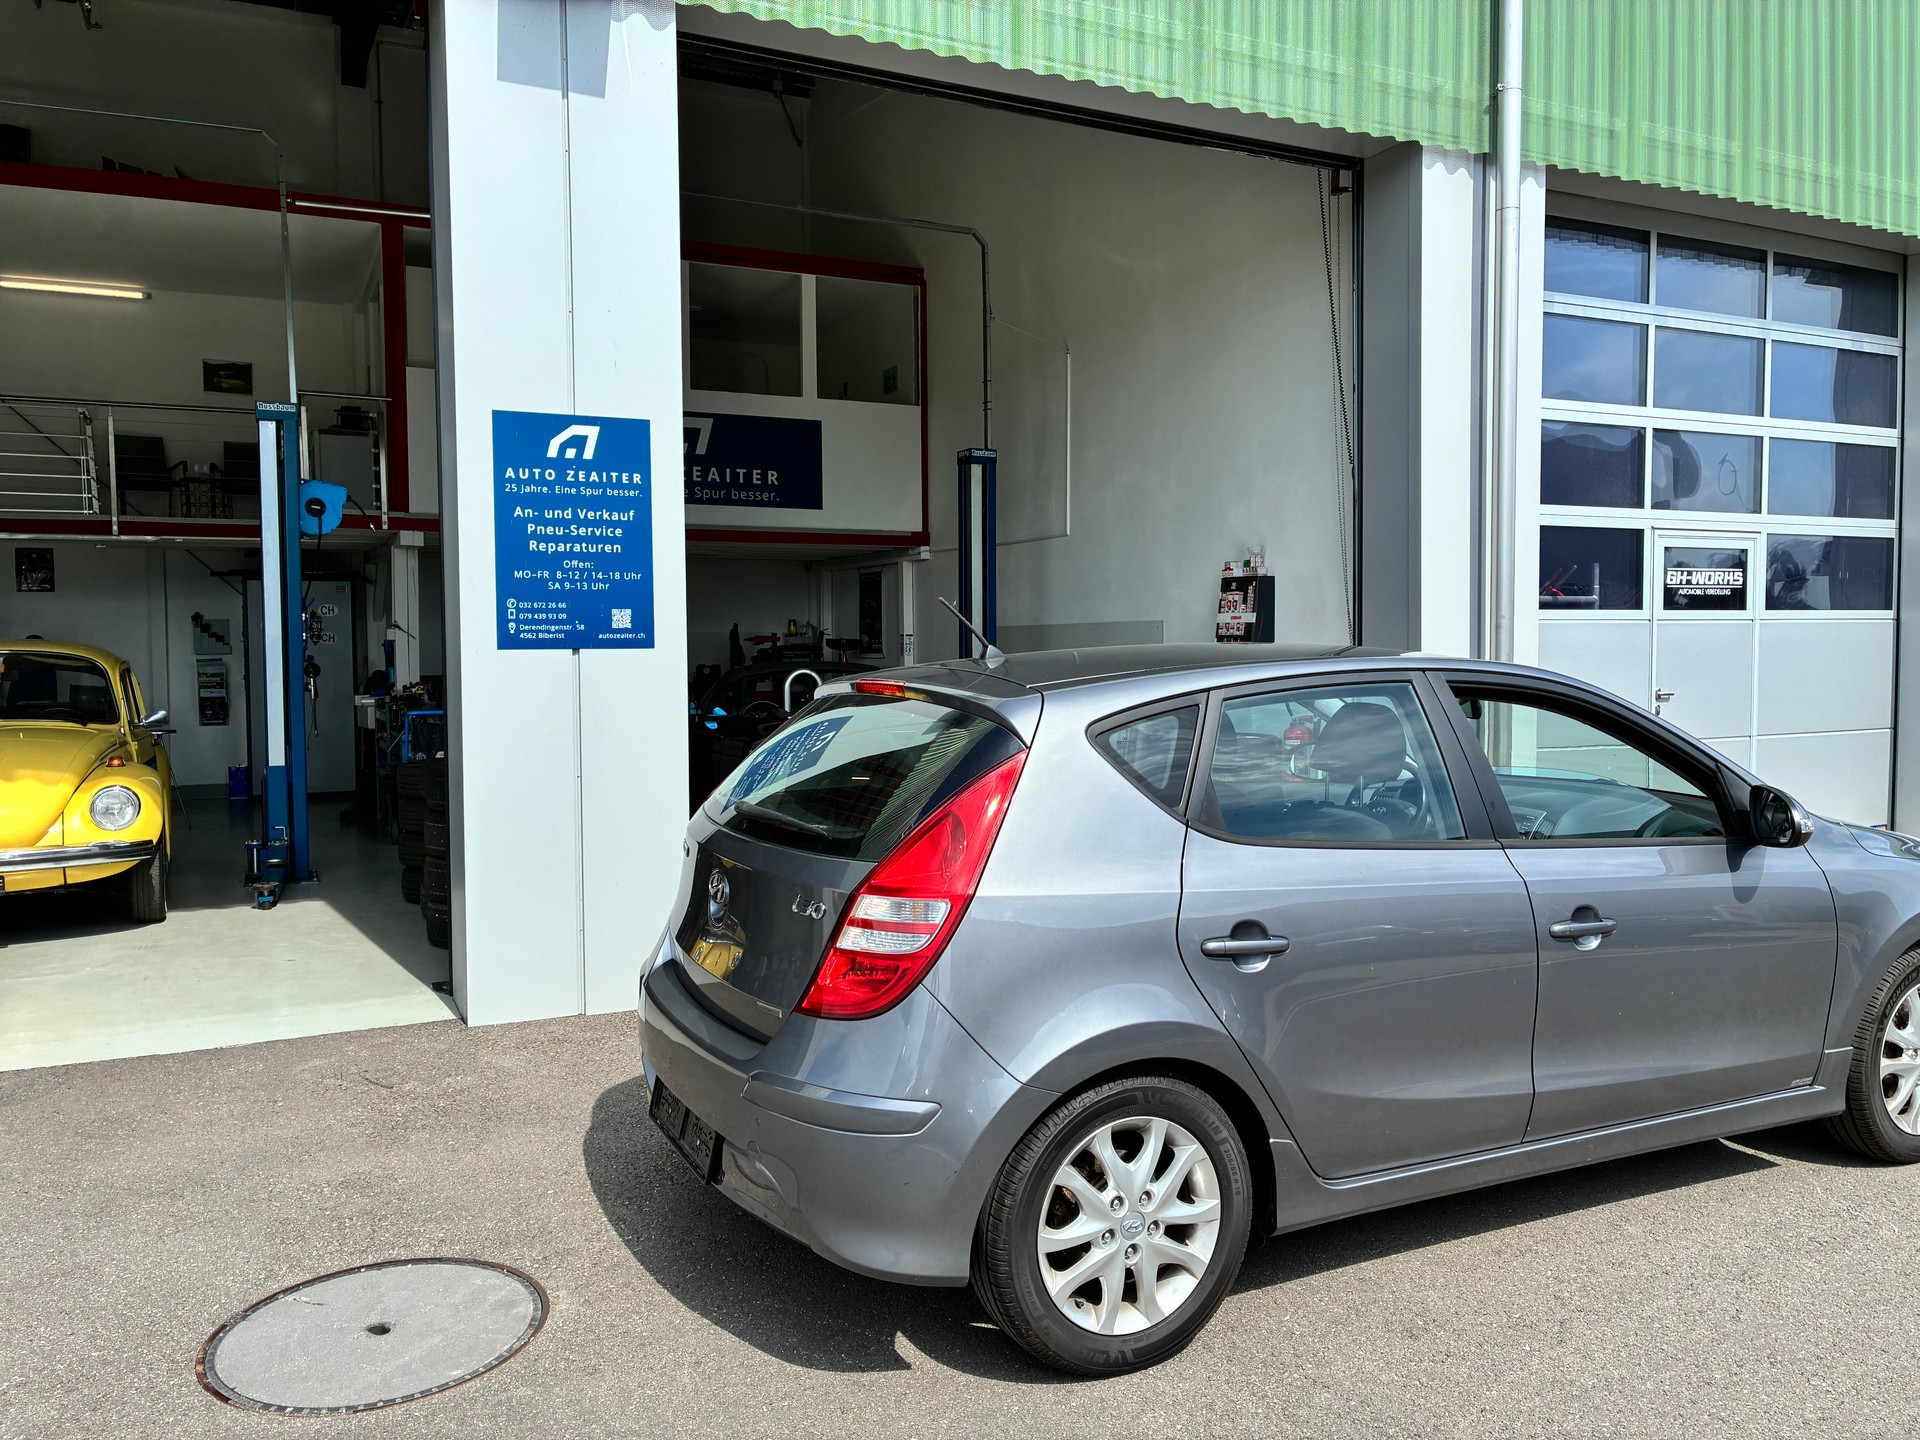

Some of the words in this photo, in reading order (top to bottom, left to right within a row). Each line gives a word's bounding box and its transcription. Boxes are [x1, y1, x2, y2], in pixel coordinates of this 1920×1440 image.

[505, 467, 556, 481] AUTO
[566, 470, 642, 484] ZEAITER
[504, 483, 517, 492] 25
[521, 484, 551, 494] Jahre.
[555, 486, 577, 495] Eine
[580, 487, 603, 496] Spur
[607, 488, 643, 497] besser.
[694, 487, 726, 500] Spur
[731, 488, 780, 501] besser.
[514, 506, 539, 518] An-
[545, 508, 572, 519] und
[577, 508, 635, 521] Verkauf
[527, 523, 623, 537] Pneu-Service
[529, 540, 621, 554] Reparaturen
[563, 560, 594, 569] Offen:
[584, 571, 588, 580] /
[624, 572, 642, 580] Uhr
[548, 582, 561, 590] SA
[591, 582, 610, 590] Uhr
[320, 605, 335, 615] CH
[518, 601, 532, 609] 032
[519, 624, 575, 632] Derendingenstr.
[321, 633, 335, 643] CH
